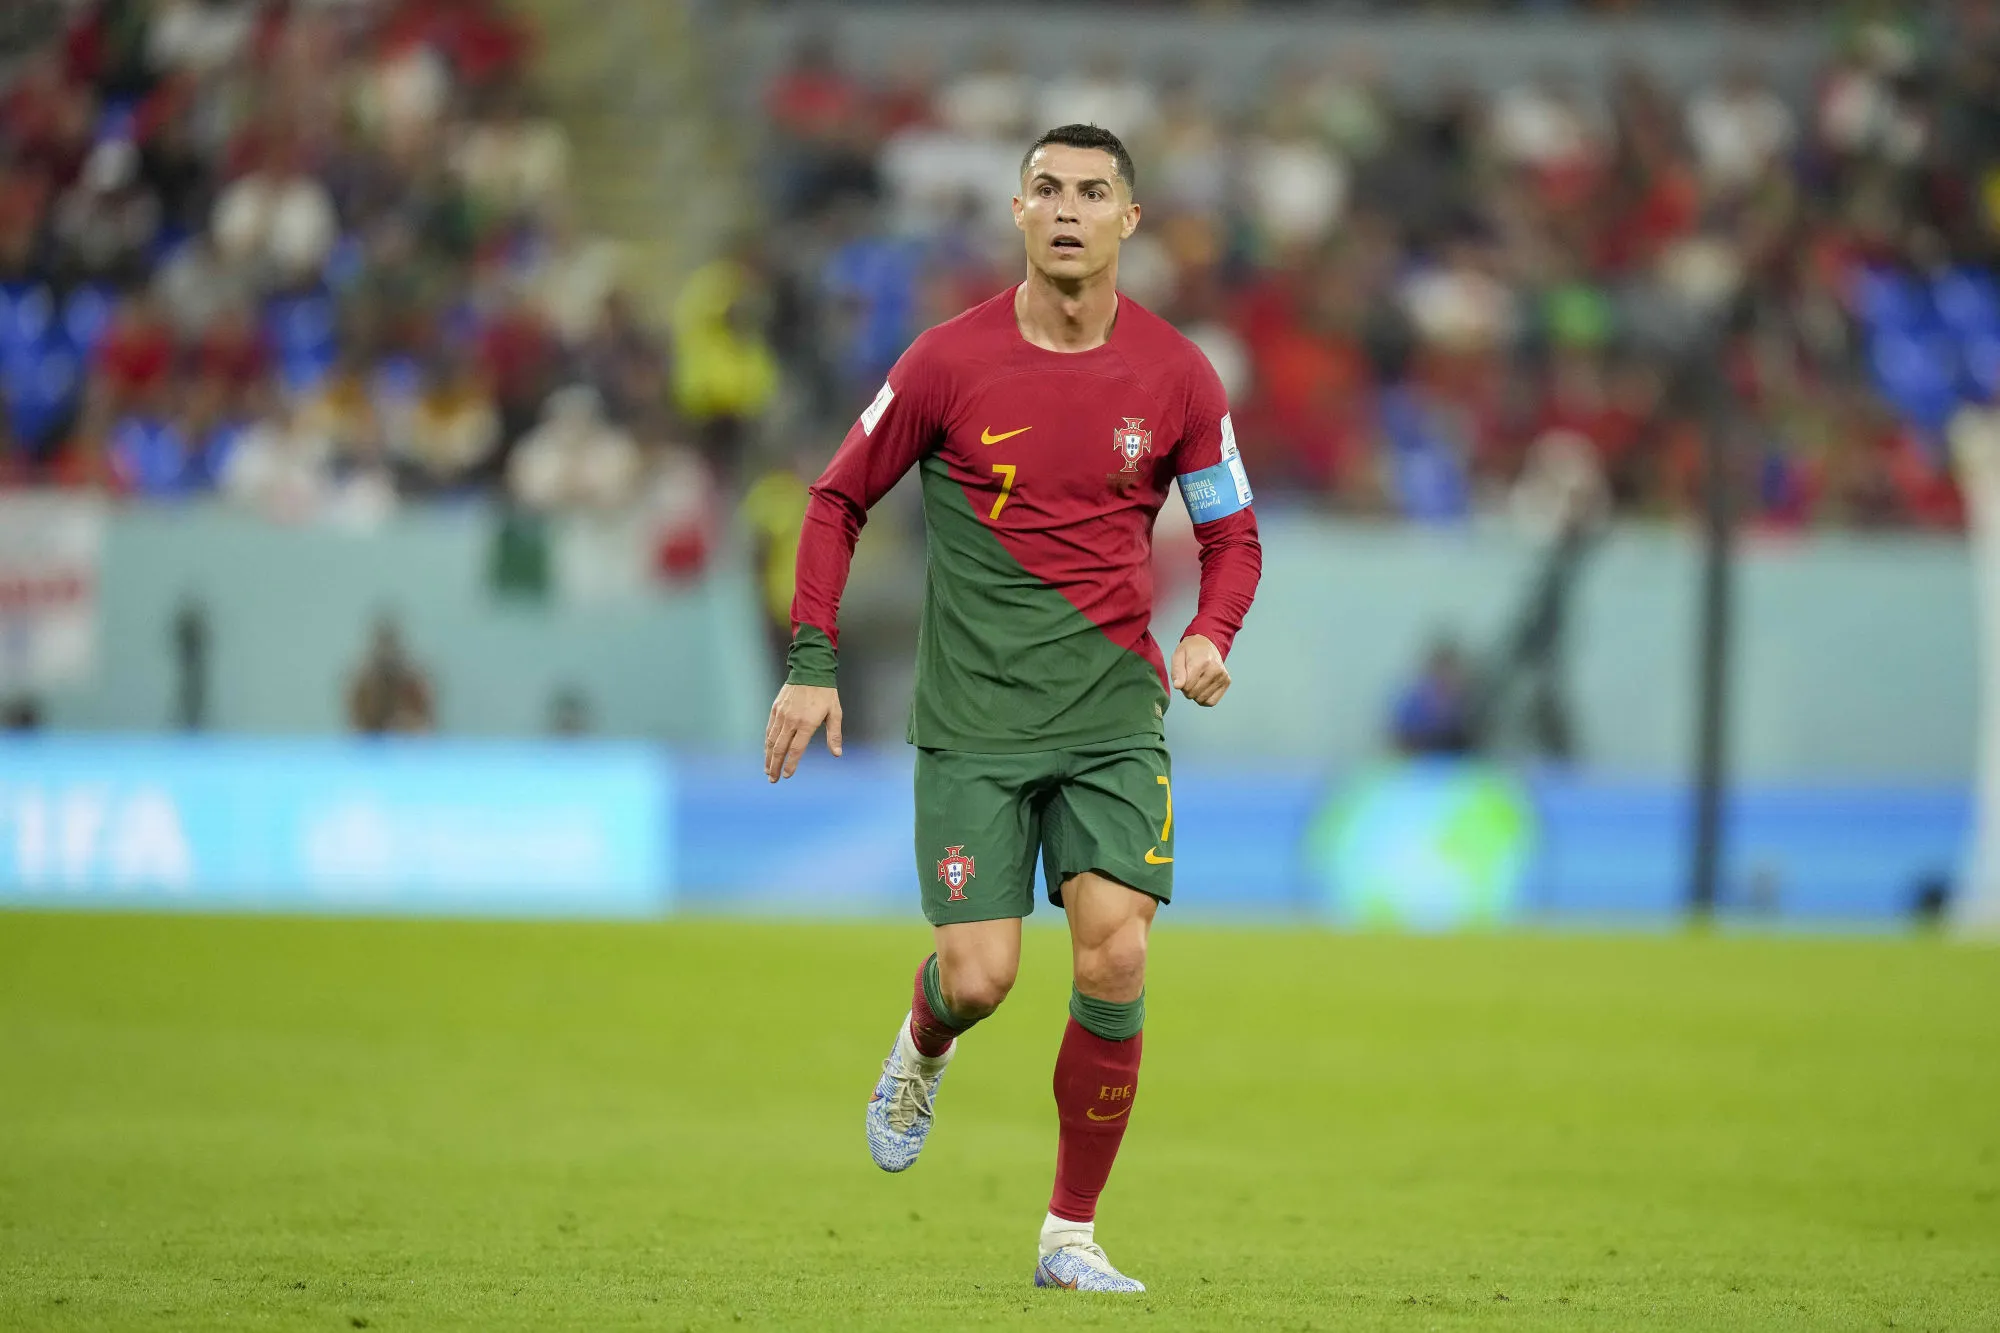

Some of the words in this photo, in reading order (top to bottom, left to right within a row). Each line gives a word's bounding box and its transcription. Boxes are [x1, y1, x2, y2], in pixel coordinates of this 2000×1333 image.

[988, 464, 1017, 521] 7
[1183, 478, 1213, 492] FOOTBALL
[1185, 485, 1217, 502] UNITES
[0, 782, 192, 892] IFA
[1157, 775, 1172, 842] 7
